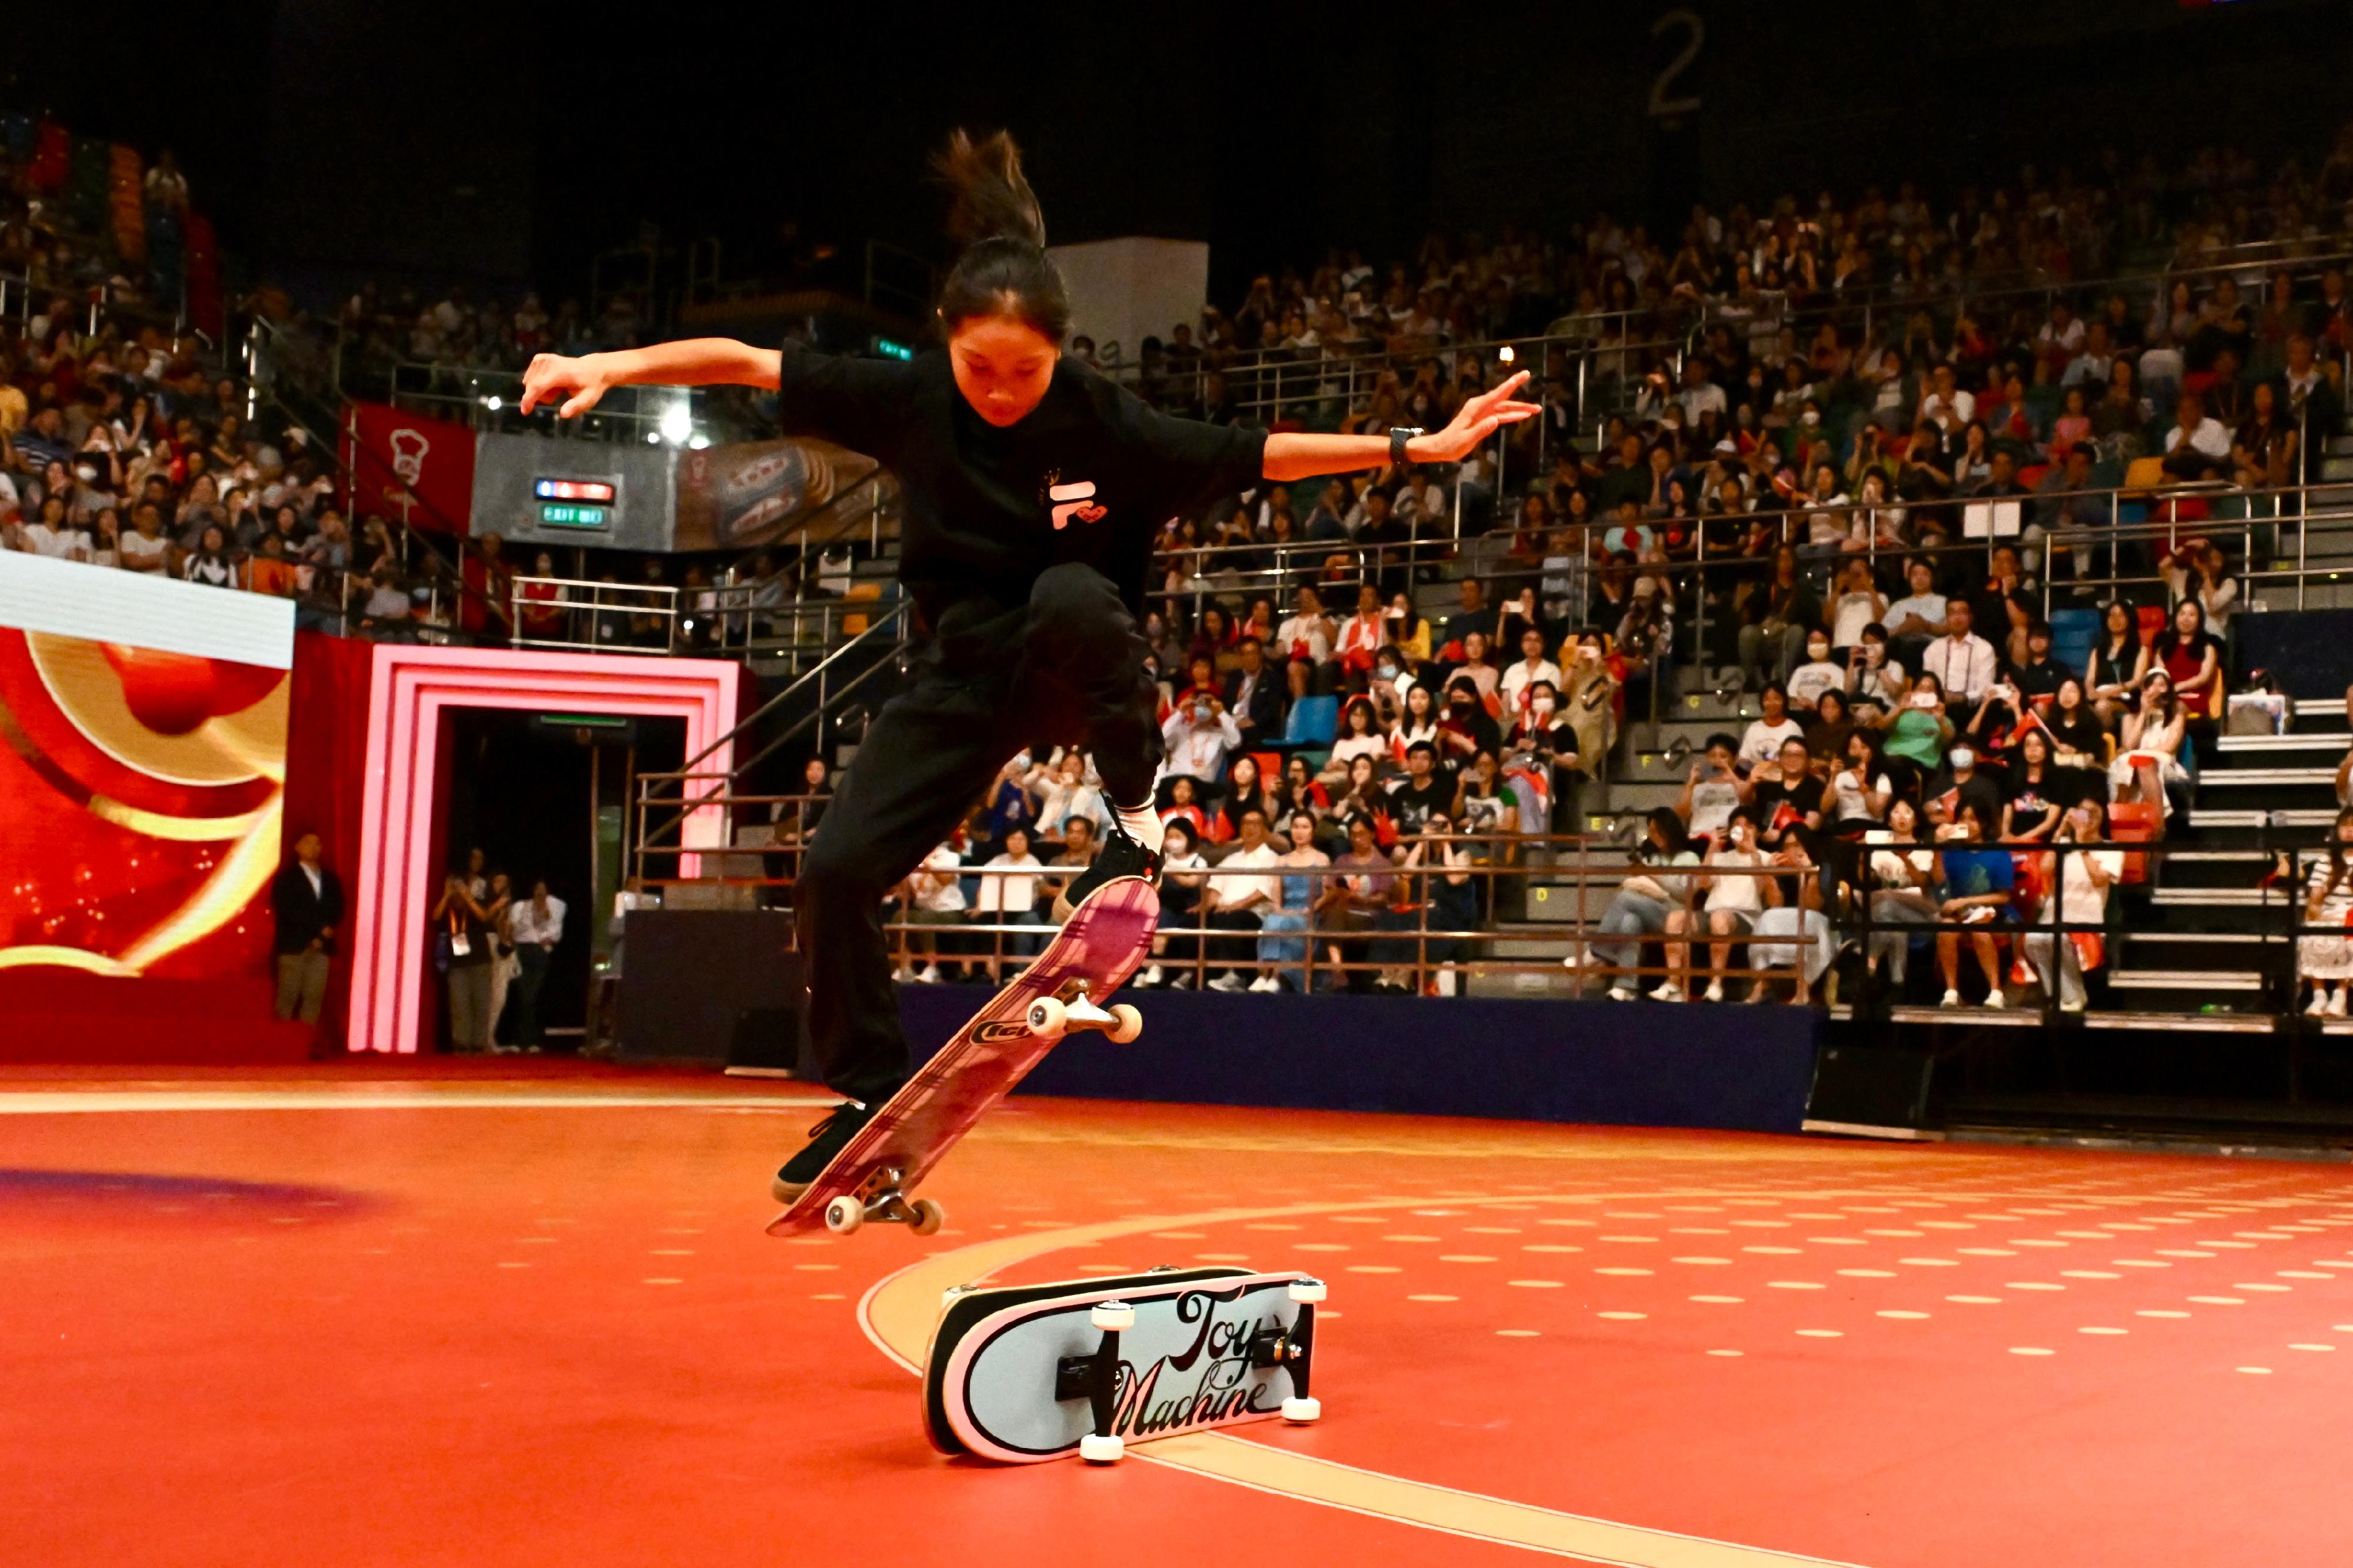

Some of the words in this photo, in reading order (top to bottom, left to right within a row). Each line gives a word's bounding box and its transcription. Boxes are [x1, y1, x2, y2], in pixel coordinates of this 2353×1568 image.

[1648, 8, 1704, 116] 2
[1166, 1285, 1266, 1389] Toy
[1116, 1355, 1282, 1437] Machine
